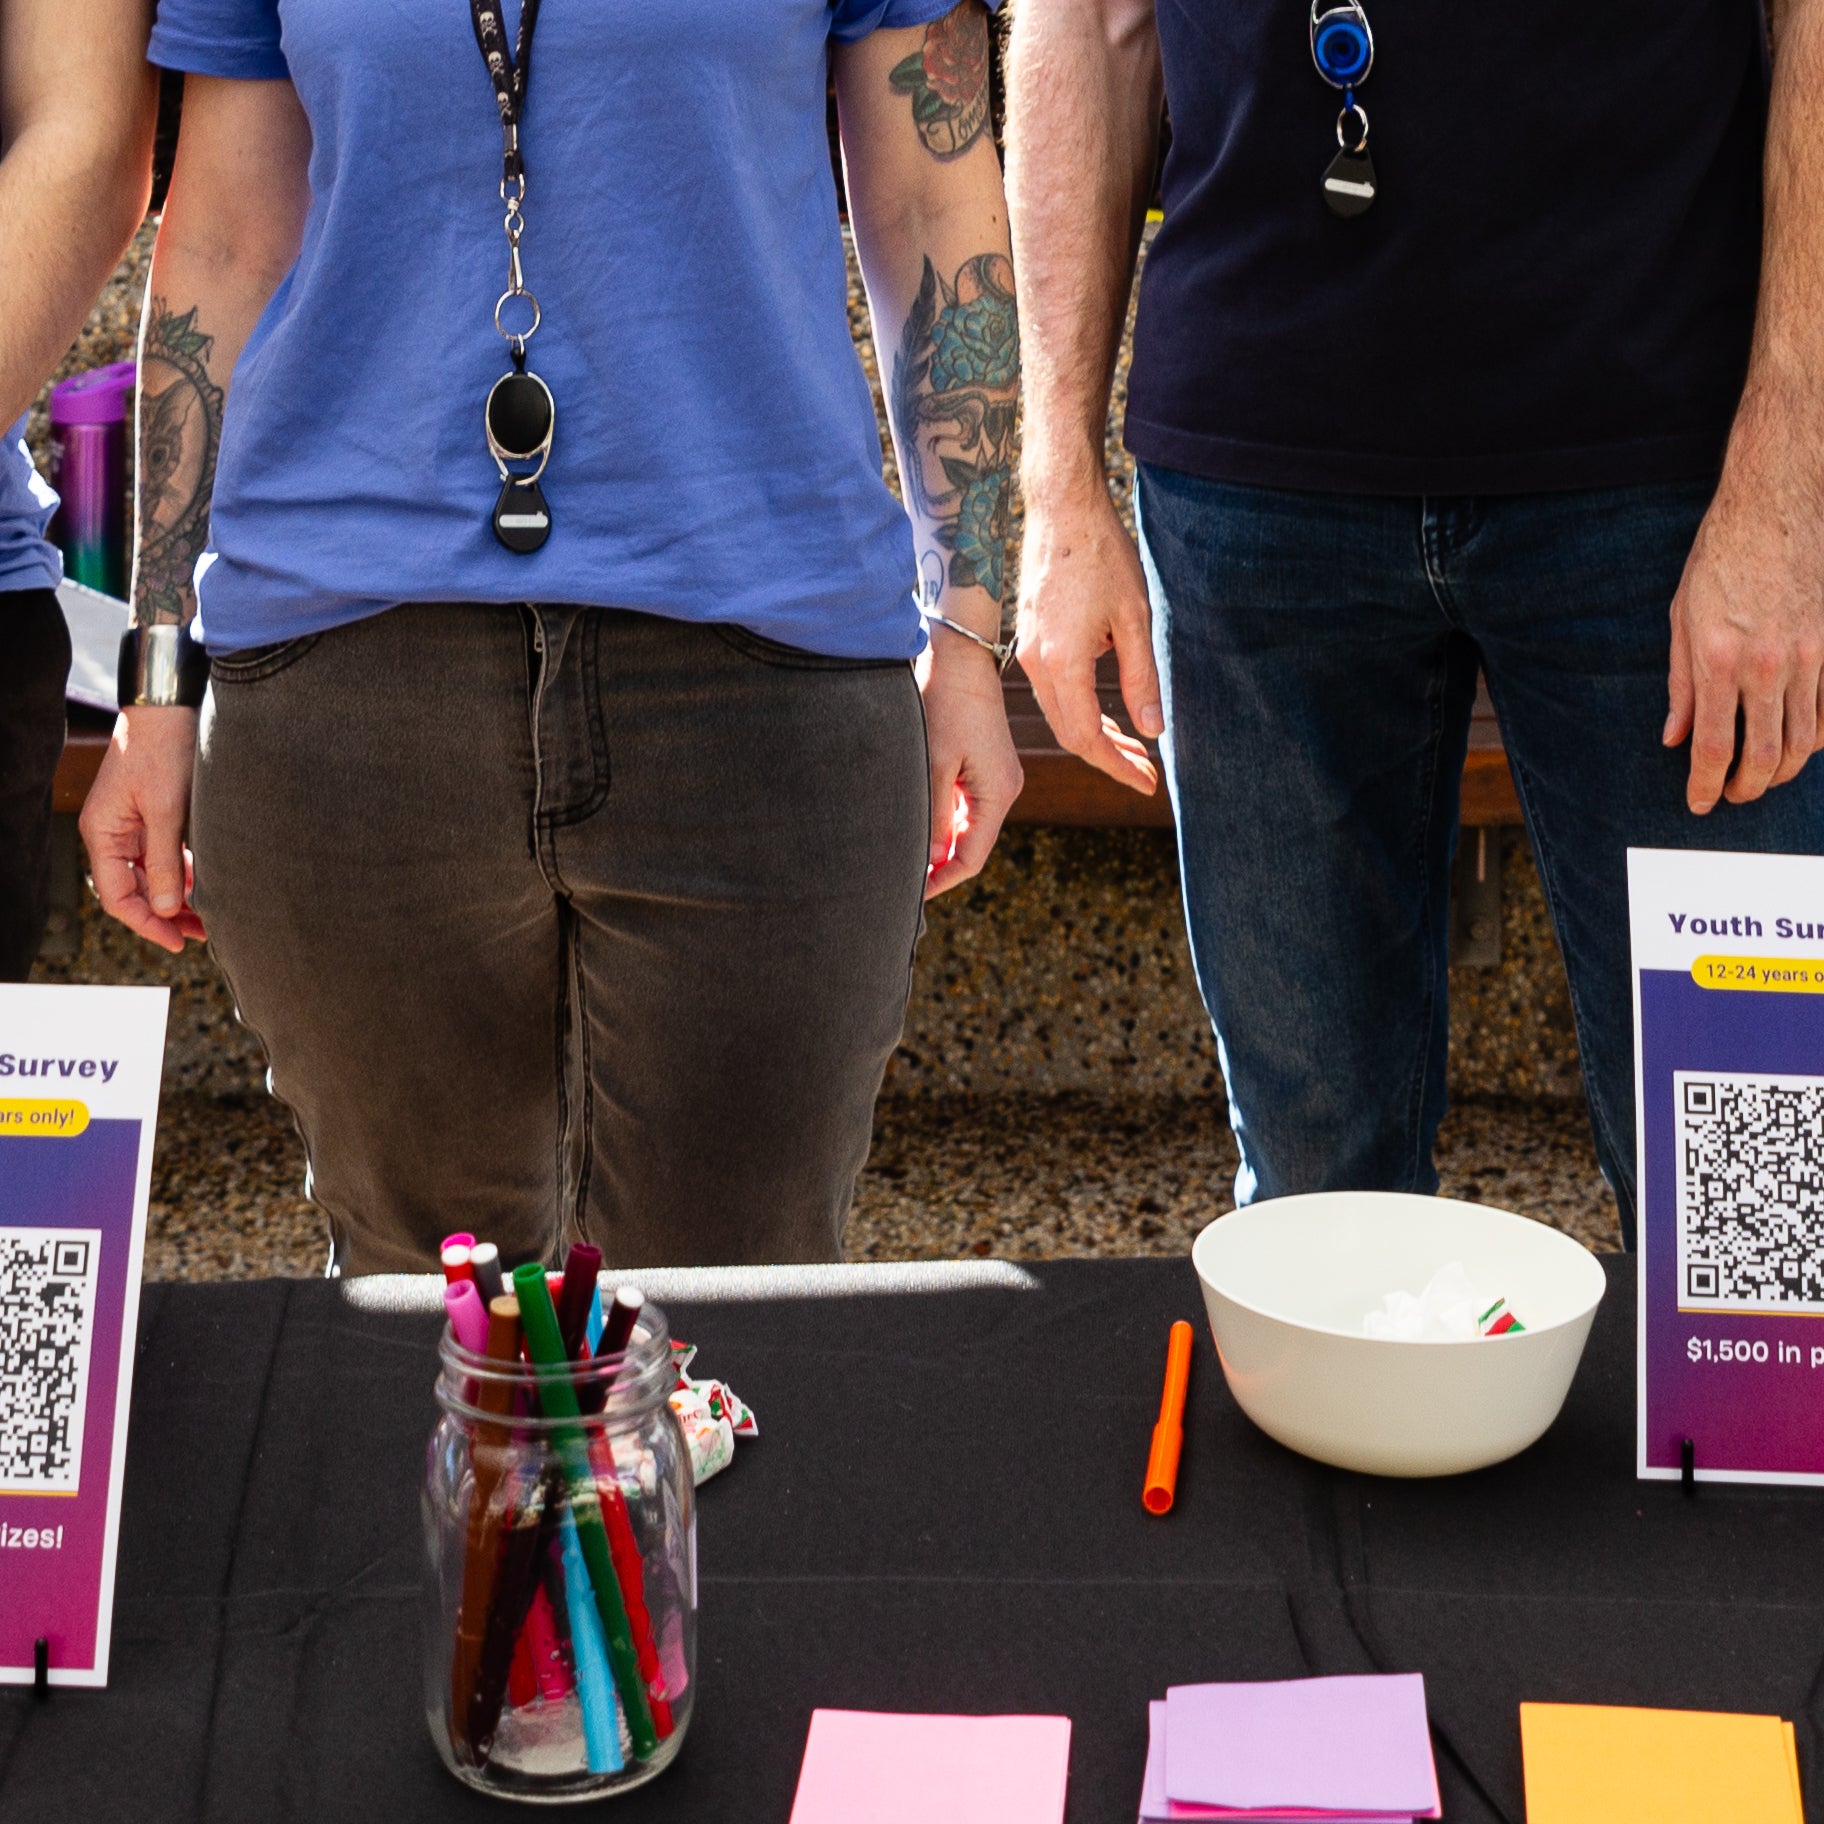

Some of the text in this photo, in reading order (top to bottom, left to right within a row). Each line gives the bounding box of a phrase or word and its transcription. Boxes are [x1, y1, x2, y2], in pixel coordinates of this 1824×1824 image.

[1668, 913, 1763, 937] Youth
[1708, 963, 1756, 980] 12-24
[1762, 969, 1809, 985] years
[29, 1107, 74, 1129] only!
[1687, 1336, 1769, 1364] $1,500
[1778, 1340, 1801, 1364] in
